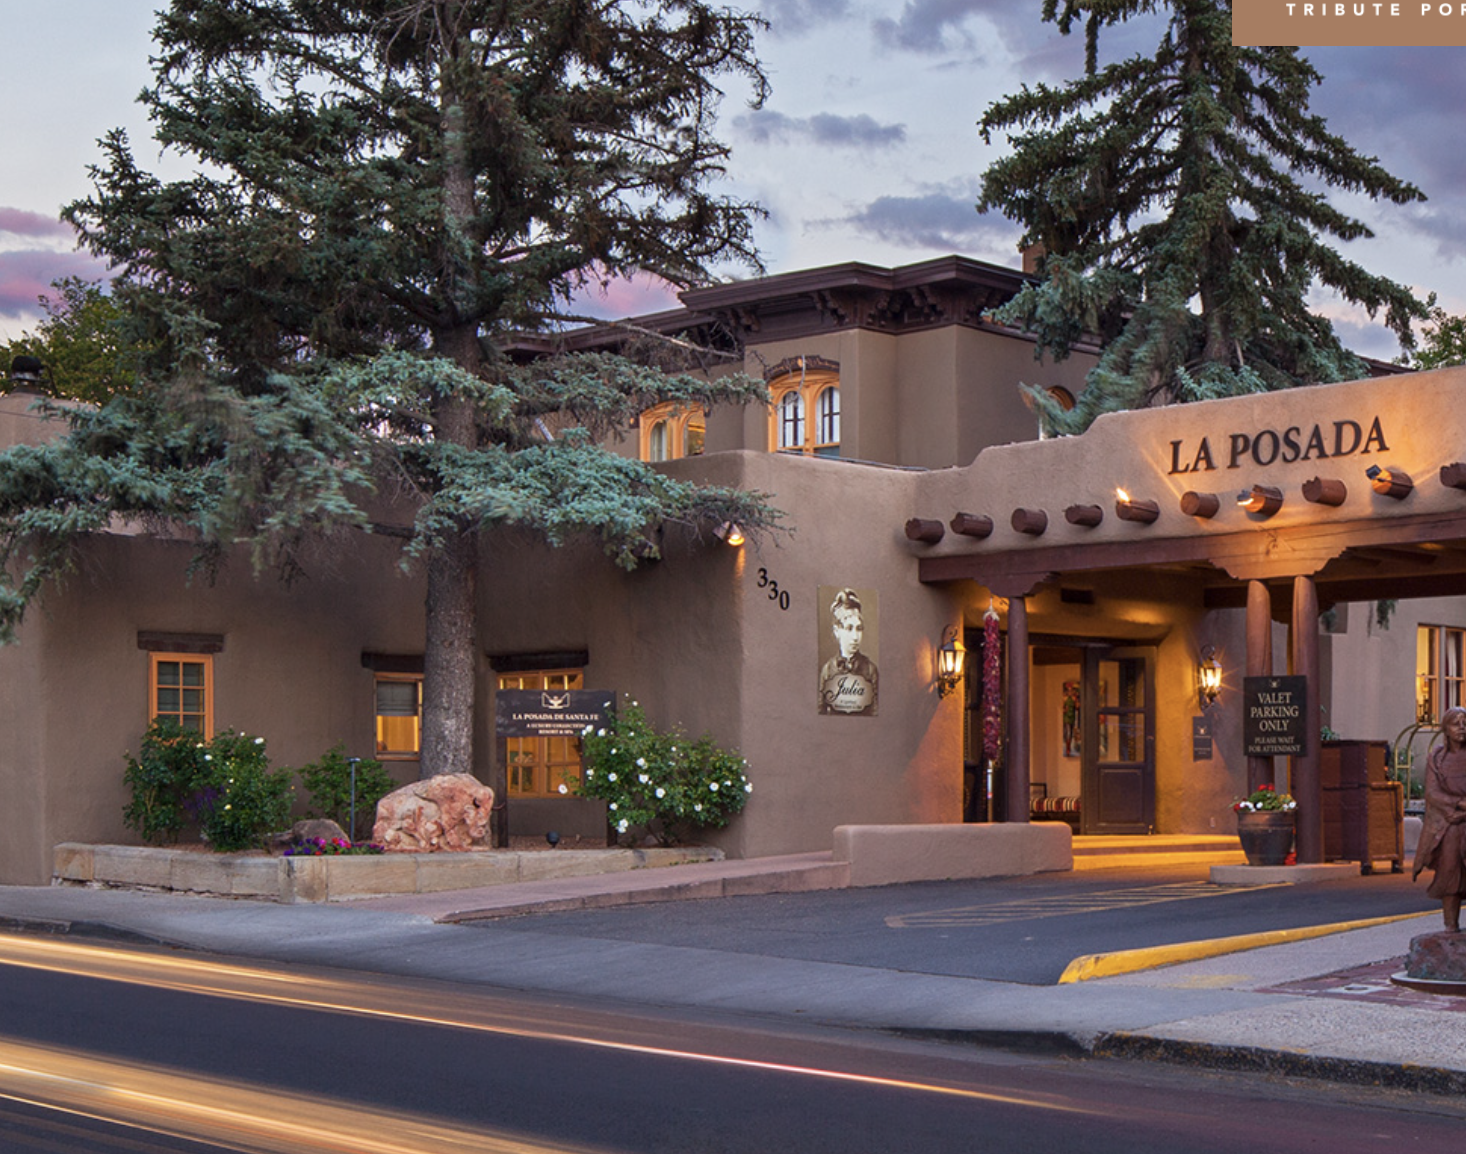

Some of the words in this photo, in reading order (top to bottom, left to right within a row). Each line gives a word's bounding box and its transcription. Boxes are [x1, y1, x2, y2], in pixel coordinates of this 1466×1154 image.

[1168, 436, 1217, 475] LA
[1227, 415, 1390, 469] POSADA
[757, 567, 790, 610] 330
[825, 676, 865, 703] Julia
[1258, 691, 1292, 704] VALET
[1250, 705, 1299, 718] PARKING
[1259, 719, 1290, 732] ONLY
[1254, 736, 1276, 744] PLEASE
[1263, 744, 1301, 752] ATTENDANT
